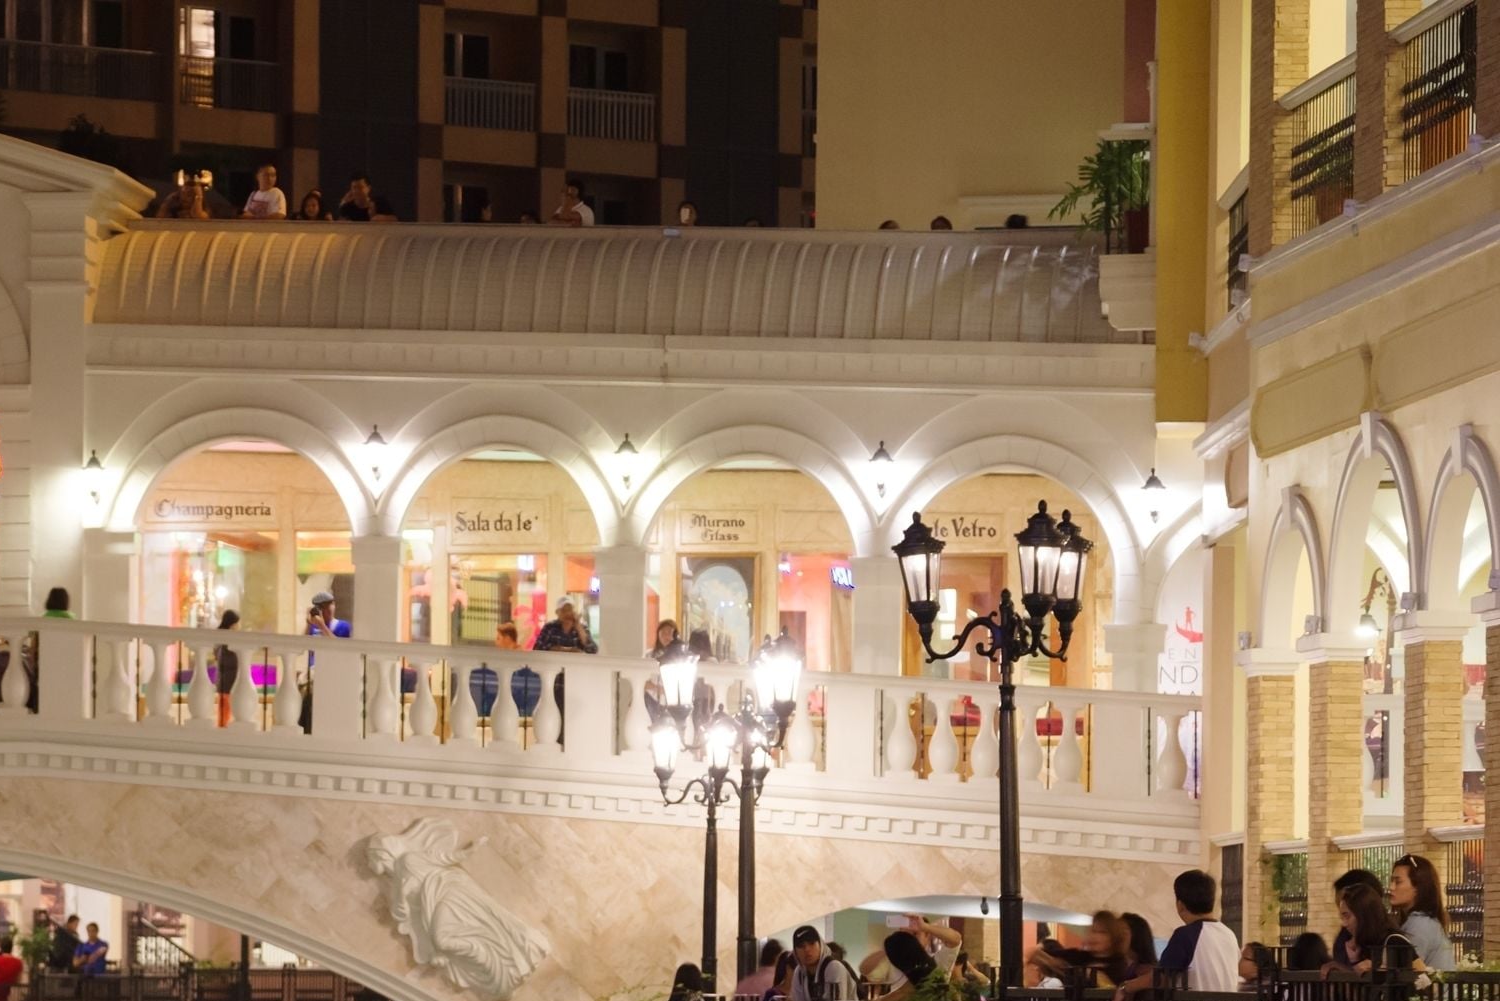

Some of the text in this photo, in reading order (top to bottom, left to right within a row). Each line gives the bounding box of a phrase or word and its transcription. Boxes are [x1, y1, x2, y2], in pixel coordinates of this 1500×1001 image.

[154, 498, 272, 520] Champagneria
[454, 511, 489, 533] Sala
[494, 511, 515, 532] da
[690, 513, 746, 528] Murano
[1159, 664, 1199, 685] ND
